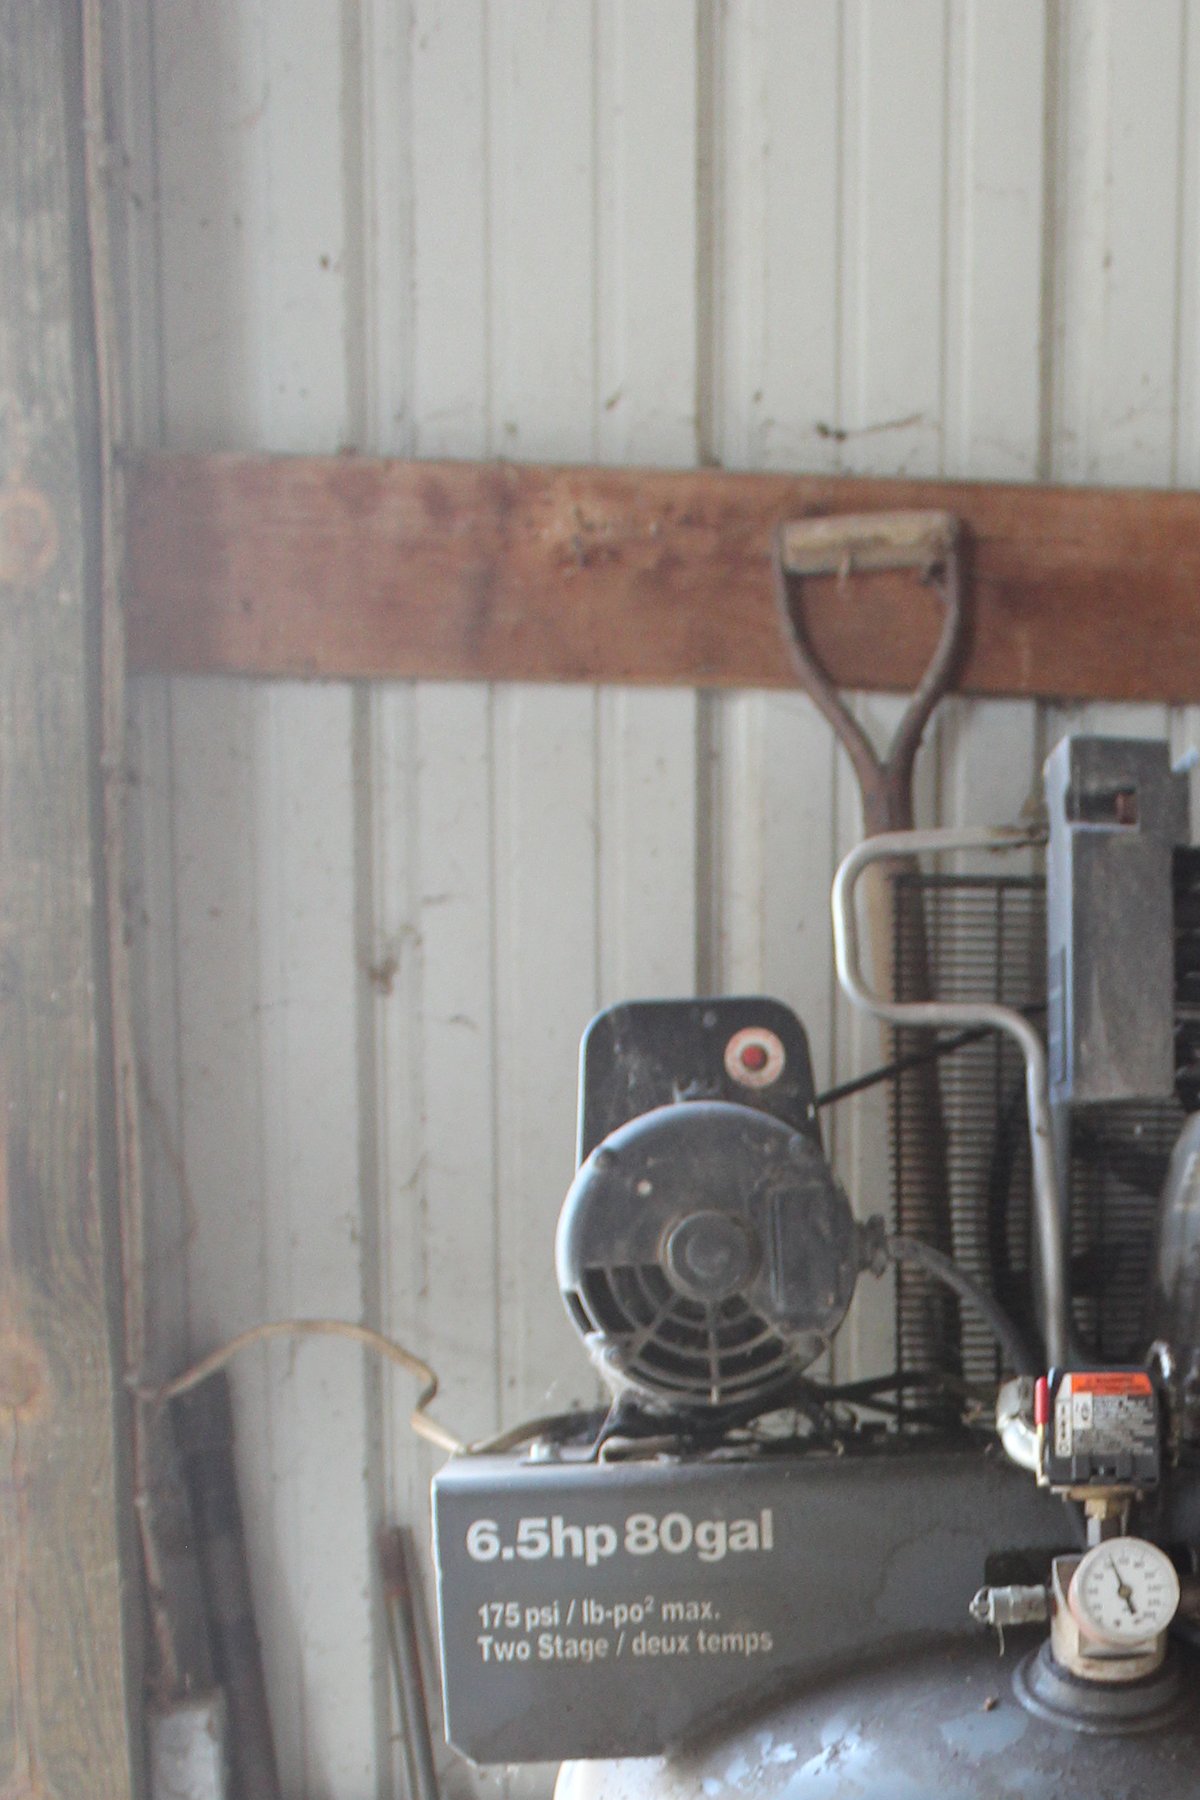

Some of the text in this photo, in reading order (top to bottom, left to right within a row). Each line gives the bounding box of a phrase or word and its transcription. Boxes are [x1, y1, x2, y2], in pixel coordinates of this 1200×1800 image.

[466, 1508, 774, 1567] 6.5hp 80gal
[477, 1602, 520, 1629] 175
[525, 1600, 560, 1632] psi
[567, 1600, 577, 1626] /
[661, 1600, 721, 1622] max.
[477, 1628, 774, 1662] Two Stage / deux temps
